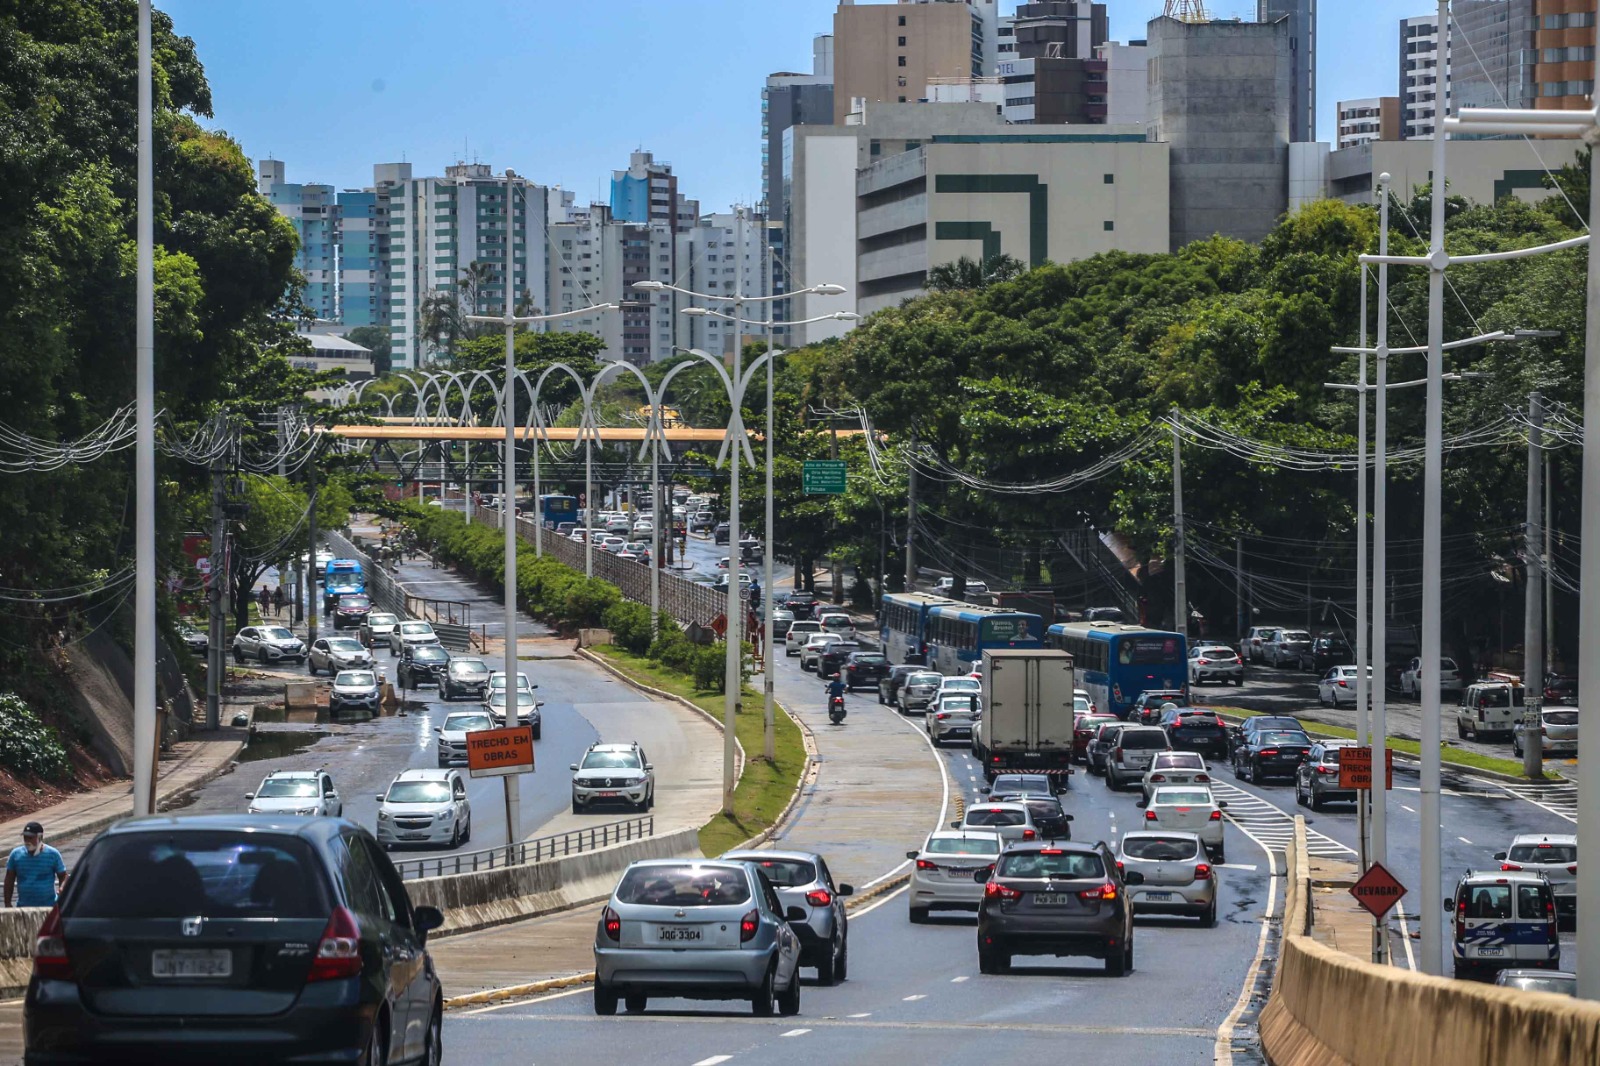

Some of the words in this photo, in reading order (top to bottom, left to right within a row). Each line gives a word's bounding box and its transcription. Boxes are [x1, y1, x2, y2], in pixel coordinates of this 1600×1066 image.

[470, 736, 509, 749] TRECHO
[513, 735, 529, 745] EM
[483, 750, 518, 762] OBRAS
[1345, 750, 1371, 758] ATEN
[1357, 886, 1398, 896] DEVAGAR
